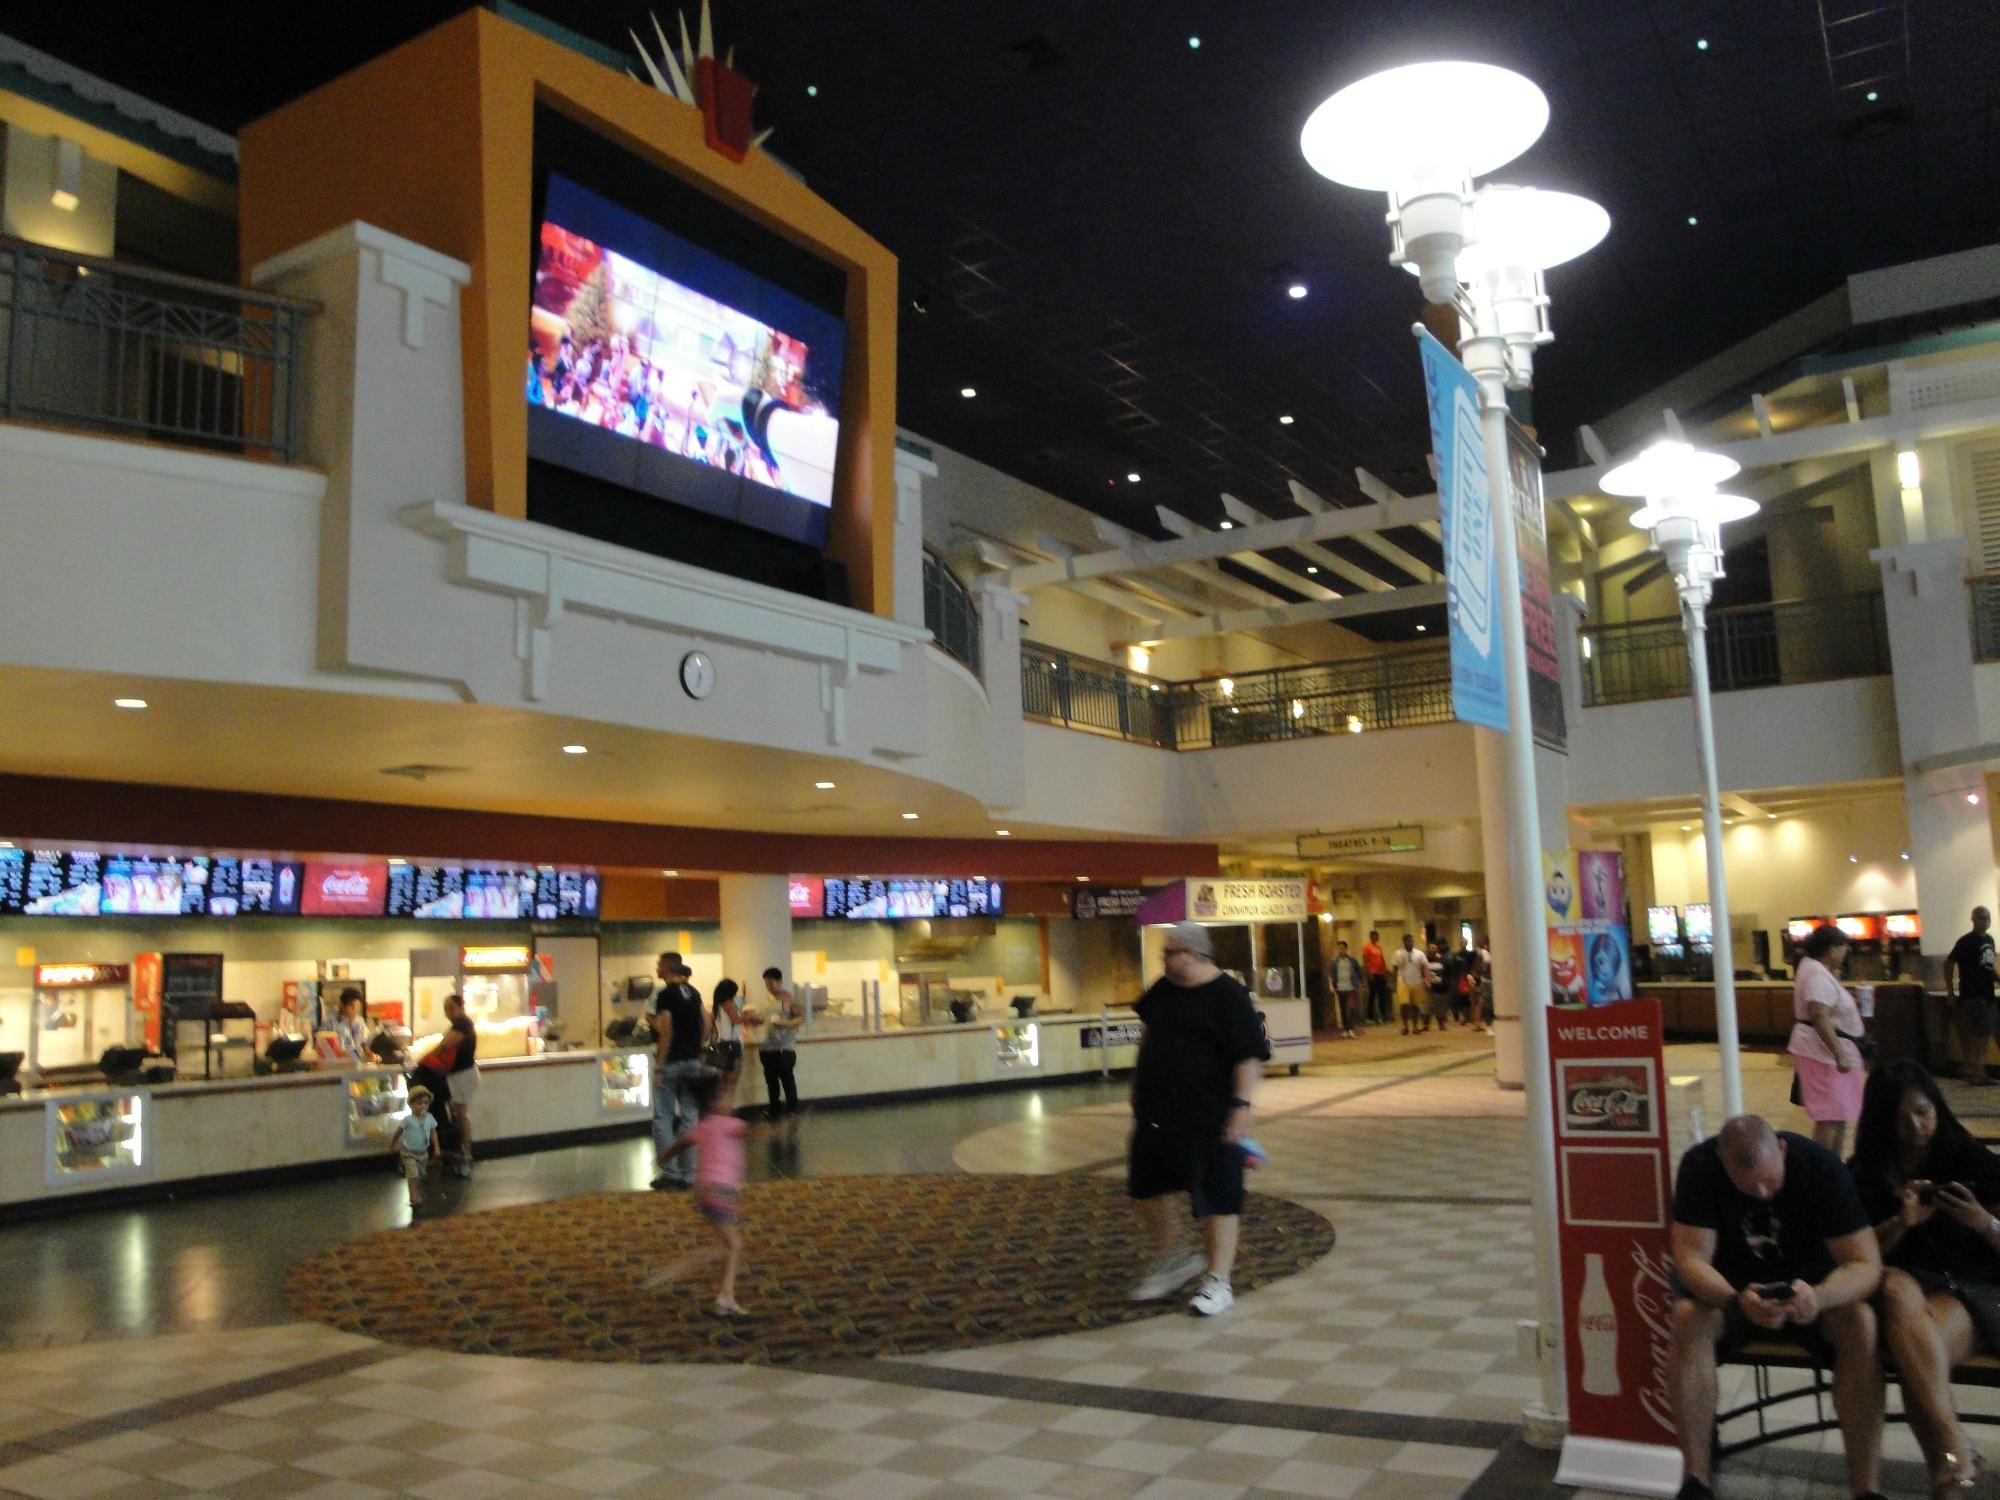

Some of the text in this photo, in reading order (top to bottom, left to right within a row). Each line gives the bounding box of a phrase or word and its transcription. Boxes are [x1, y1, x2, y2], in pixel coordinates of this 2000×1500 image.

[1223, 884, 1255, 899] FRESH
[1257, 884, 1302, 899] ROASTED
[1558, 1024, 1649, 1041] WELCOME
